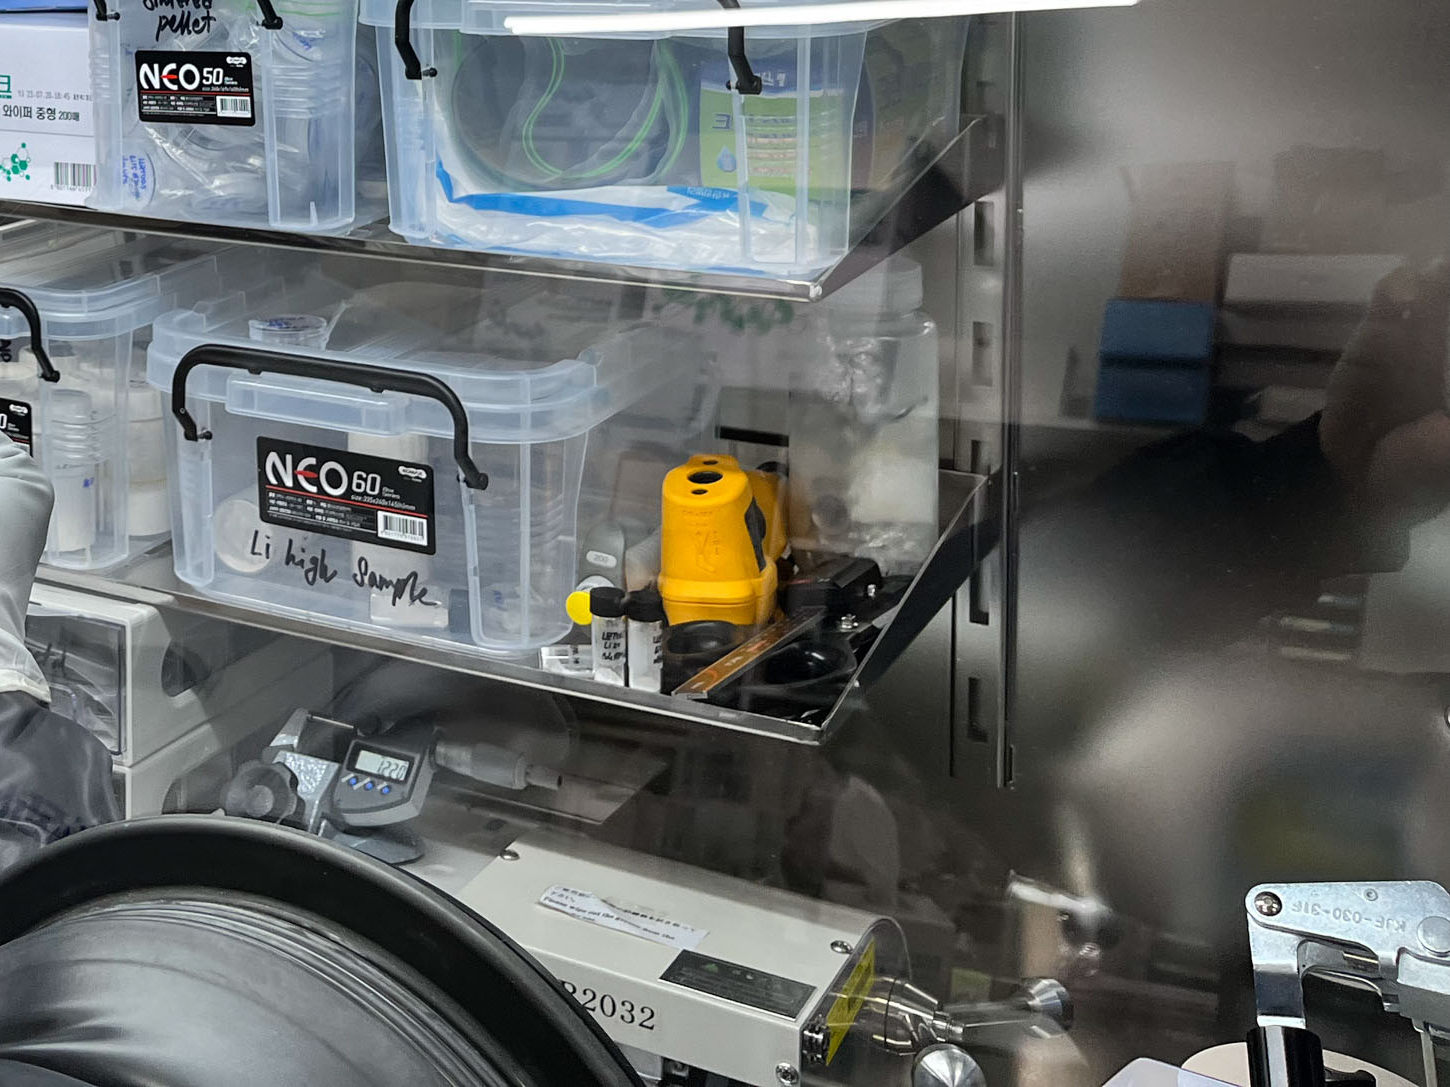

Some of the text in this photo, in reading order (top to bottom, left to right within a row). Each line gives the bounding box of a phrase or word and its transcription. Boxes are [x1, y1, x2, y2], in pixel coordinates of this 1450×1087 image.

[155, 10, 217, 42] pellet
[139, 62, 223, 91] NEO 50
[2, 104, 32, 119] 와이퍼
[36, 107, 56, 121] 중형
[265, 451, 382, 496] NEO 60
[251, 529, 271, 560] Li
[285, 538, 338, 586] high
